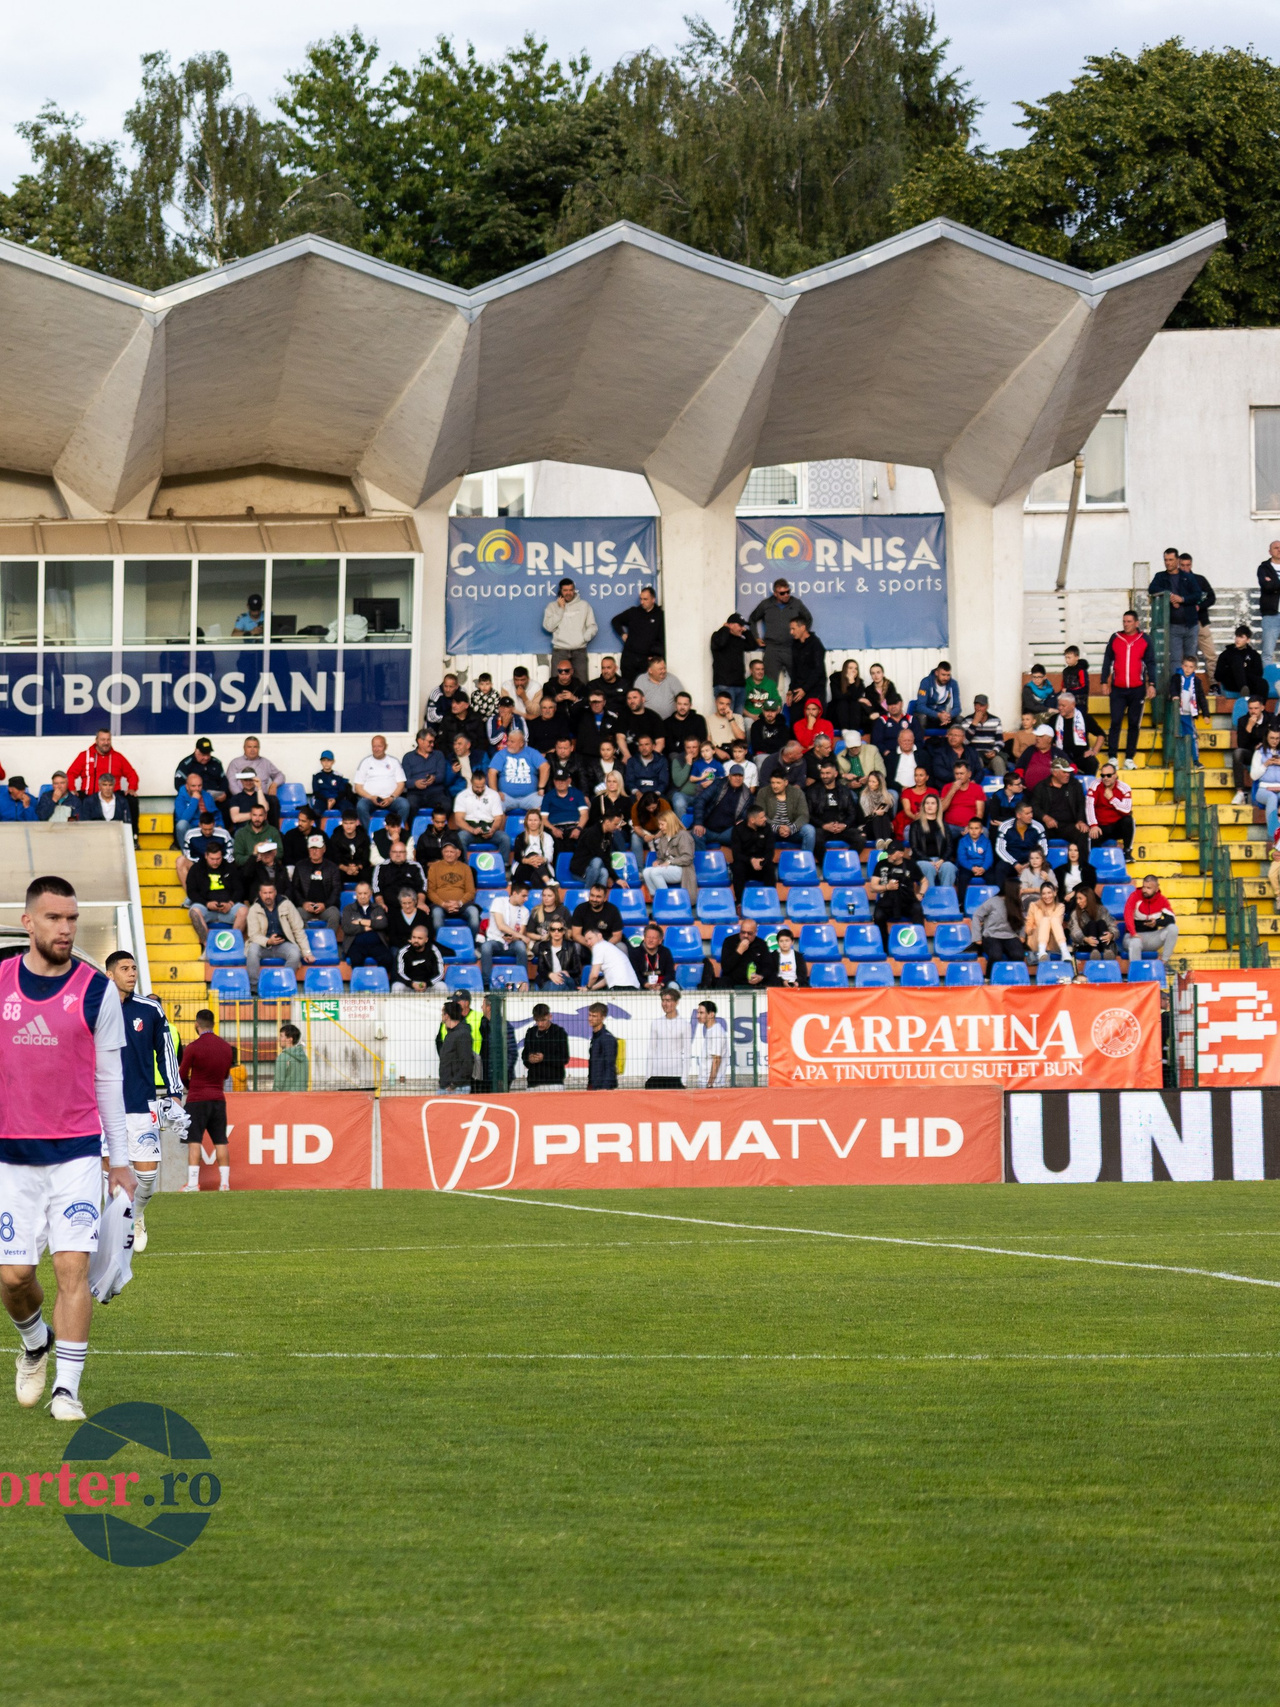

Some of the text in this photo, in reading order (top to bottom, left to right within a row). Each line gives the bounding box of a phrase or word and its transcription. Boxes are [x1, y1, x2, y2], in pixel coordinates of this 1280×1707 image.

[450, 580, 556, 600] aquapark
[855, 577, 869, 592] &
[879, 575, 943, 595] sports
[62, 670, 344, 723] BOTOȘANI
[150, 818, 157, 831] 7
[1138, 846, 1146, 858] 6
[1245, 845, 1253, 858] 6
[1258, 883, 1266, 896] 5
[158, 891, 166, 905] 5
[1270, 920, 1278, 932] 4
[164, 928, 172, 942] 4
[170, 967, 178, 980] 3
[2, 1003, 21, 1021] 88
[174, 1005, 181, 1017] 2
[12, 1033, 58, 1046] adidas
[790, 1010, 1083, 1063] CARPATINA
[792, 1061, 1083, 1083] APA ȚINUTULUI CU SUFLET BUN
[880, 1117, 964, 1159] HD
[1010, 1090, 1264, 1183] UNI
[249, 1123, 333, 1165] HD
